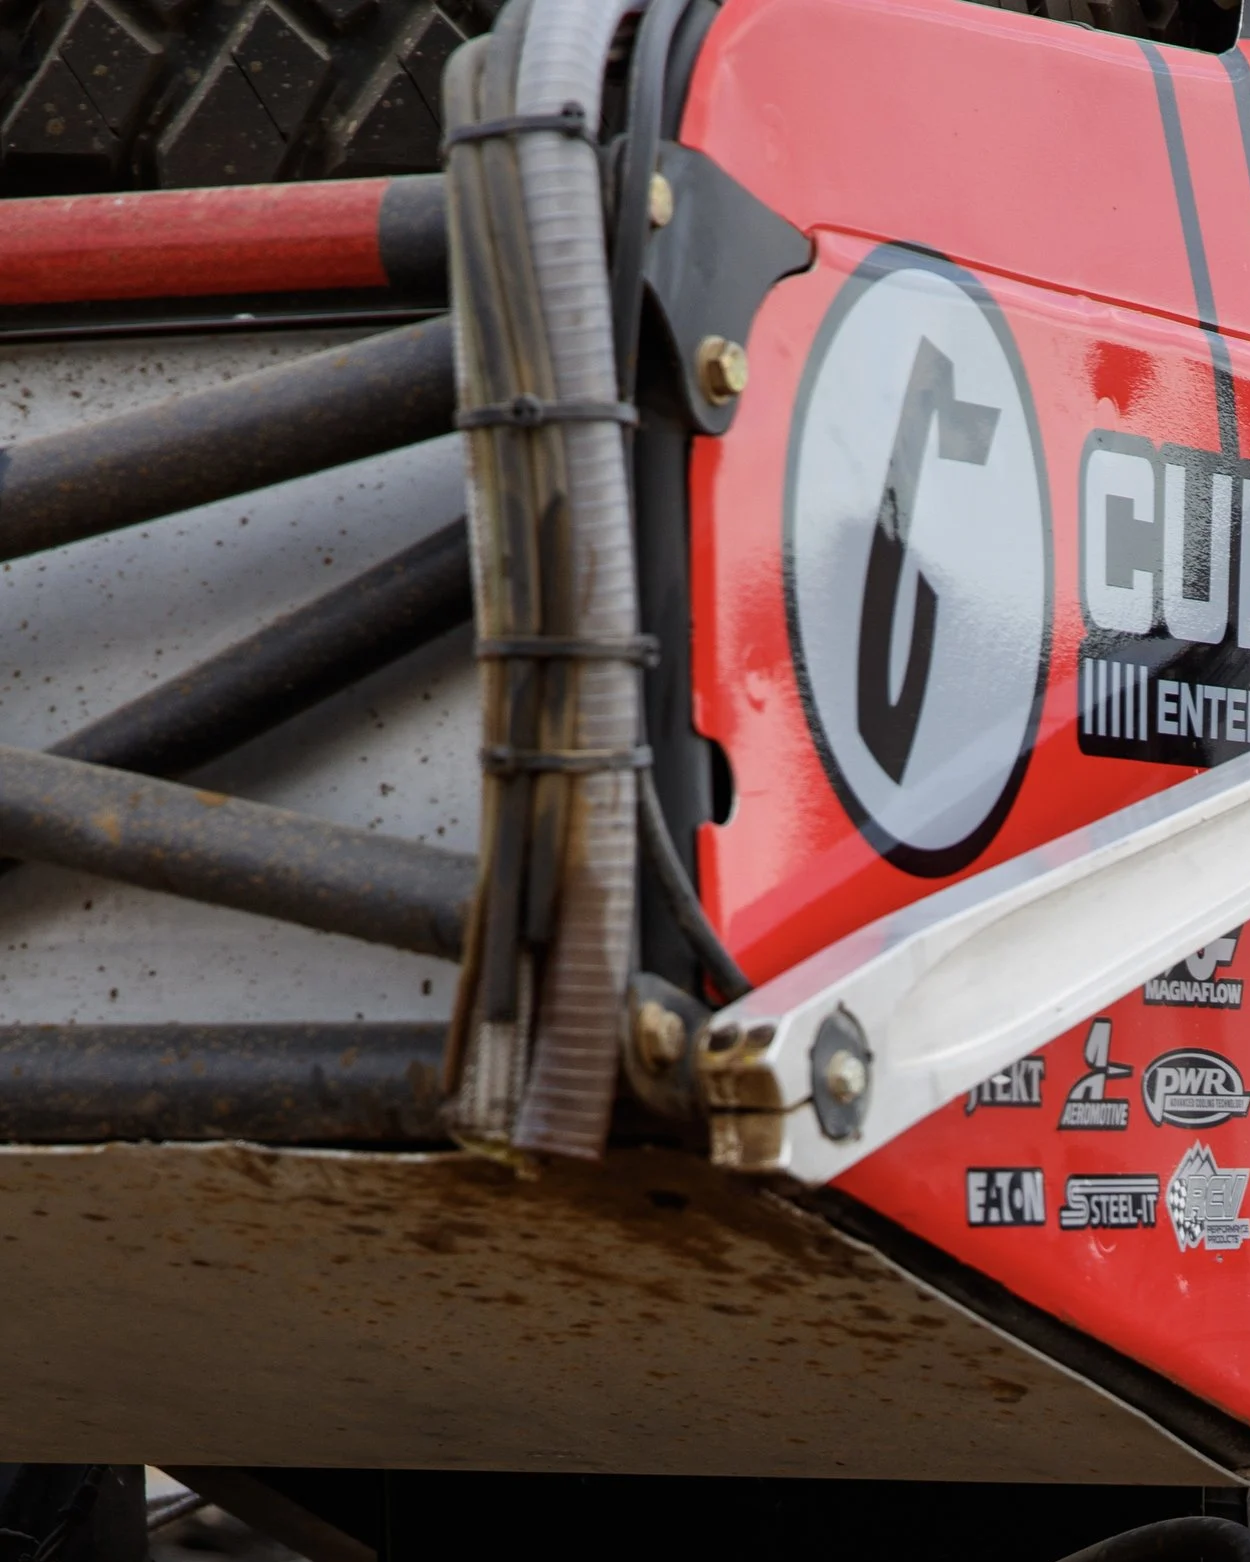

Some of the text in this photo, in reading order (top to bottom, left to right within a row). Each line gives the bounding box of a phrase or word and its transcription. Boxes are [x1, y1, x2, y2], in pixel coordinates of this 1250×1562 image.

[1145, 979, 1242, 1004] MAGNAFLOW
[1156, 1066, 1238, 1112] PWR
[1061, 1102, 1129, 1126] AEROMOTIVE
[968, 1171, 1046, 1224] EATON
[1090, 1194, 1158, 1225] STEEL-IT
[1184, 1174, 1248, 1222] REV
